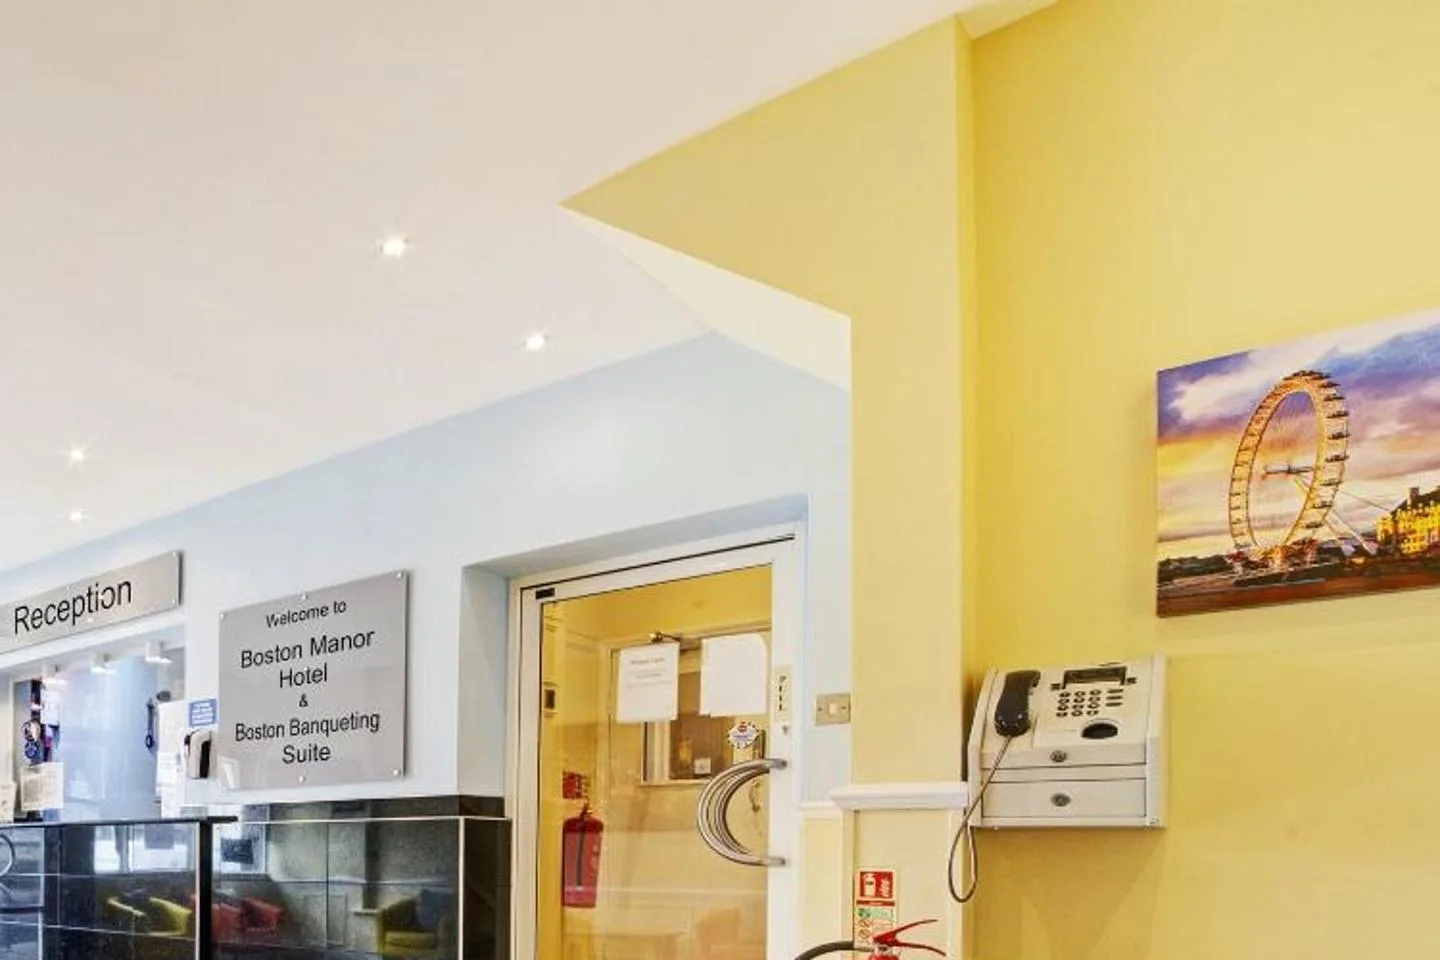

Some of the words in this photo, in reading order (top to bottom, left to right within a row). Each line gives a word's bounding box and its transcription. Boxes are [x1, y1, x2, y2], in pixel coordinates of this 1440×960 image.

[14, 580, 132, 635] Reception
[266, 604, 329, 629] Welcome
[333, 600, 348, 614] to
[241, 643, 303, 669] Boston
[310, 630, 376, 657] Manor
[279, 661, 328, 689] Hotel
[298, 693, 309, 708] &
[235, 723, 286, 742] Boston
[289, 711, 381, 738] Banqueting
[282, 743, 332, 765] Suite
